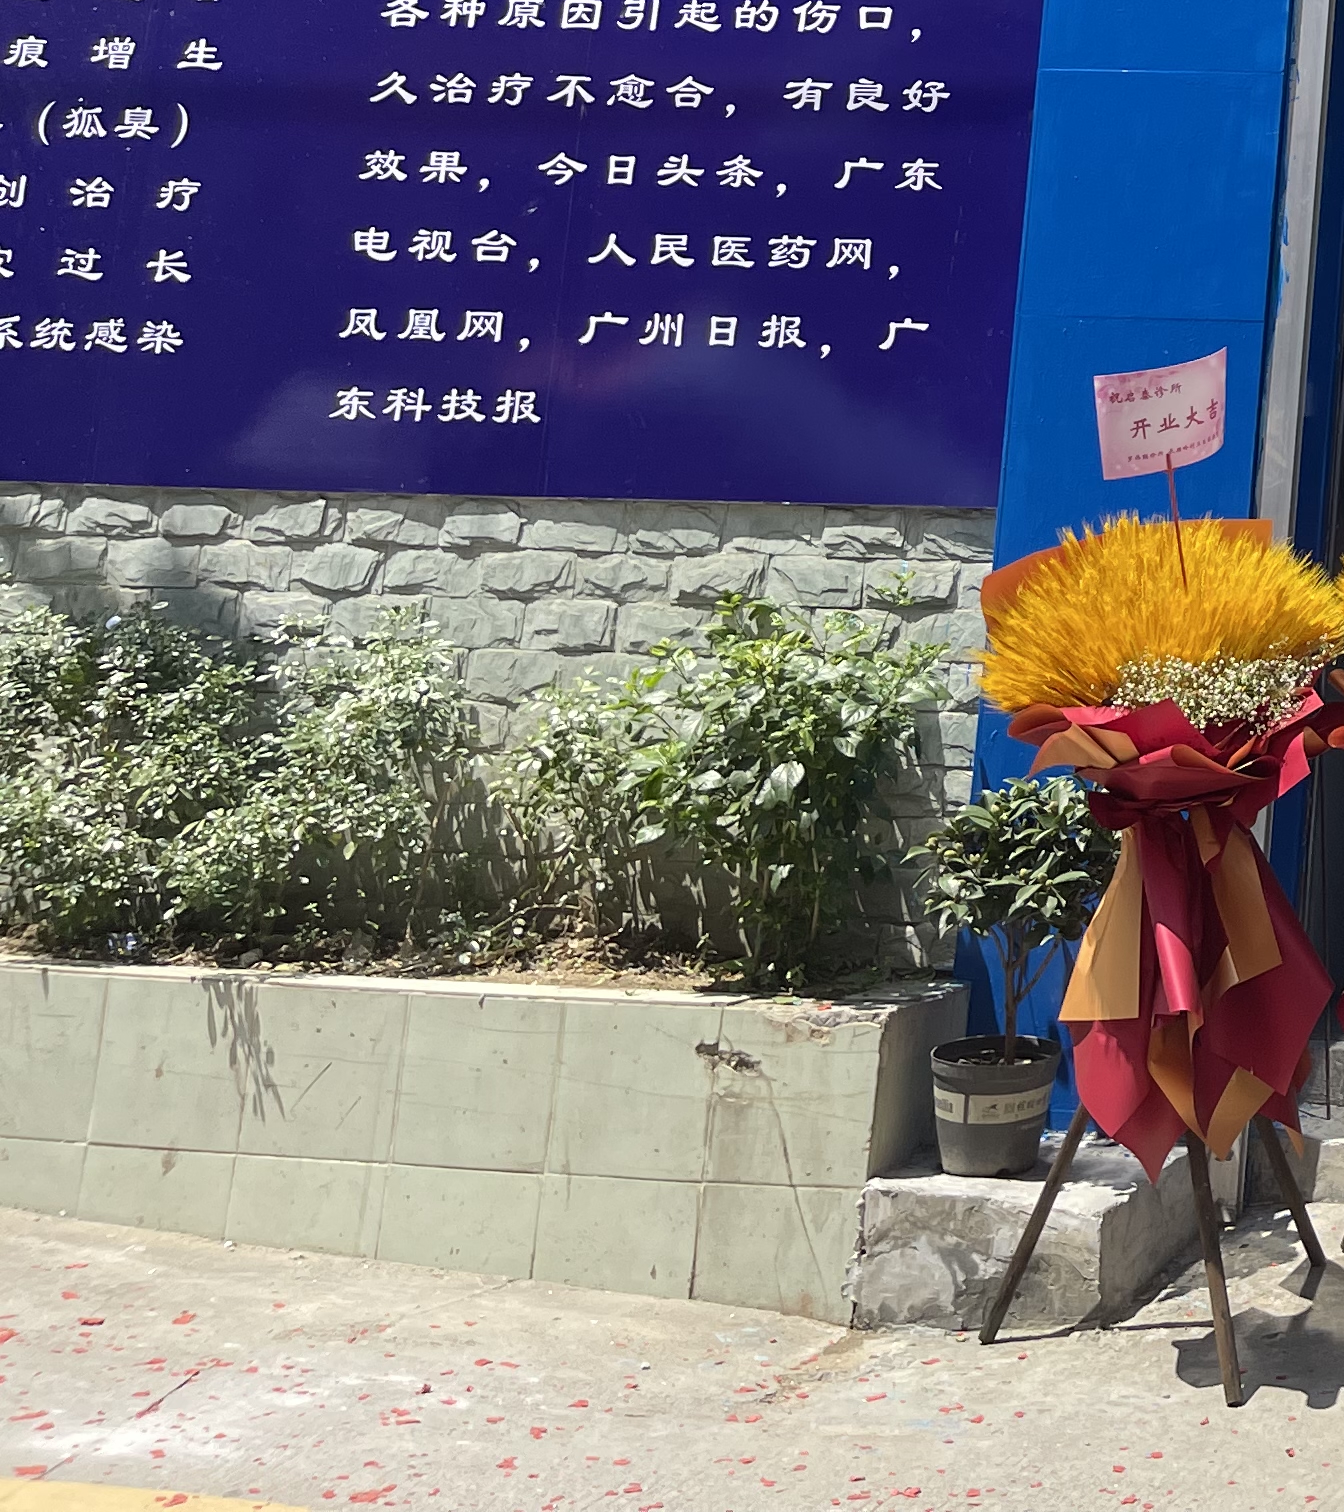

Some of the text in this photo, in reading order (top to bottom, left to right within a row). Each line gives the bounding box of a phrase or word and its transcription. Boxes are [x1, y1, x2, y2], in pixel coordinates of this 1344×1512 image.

[2, 34, 224, 72] 痕增生
[327, 385, 542, 425] 东科技报
[1130, 398, 1219, 440] 开业大吉
